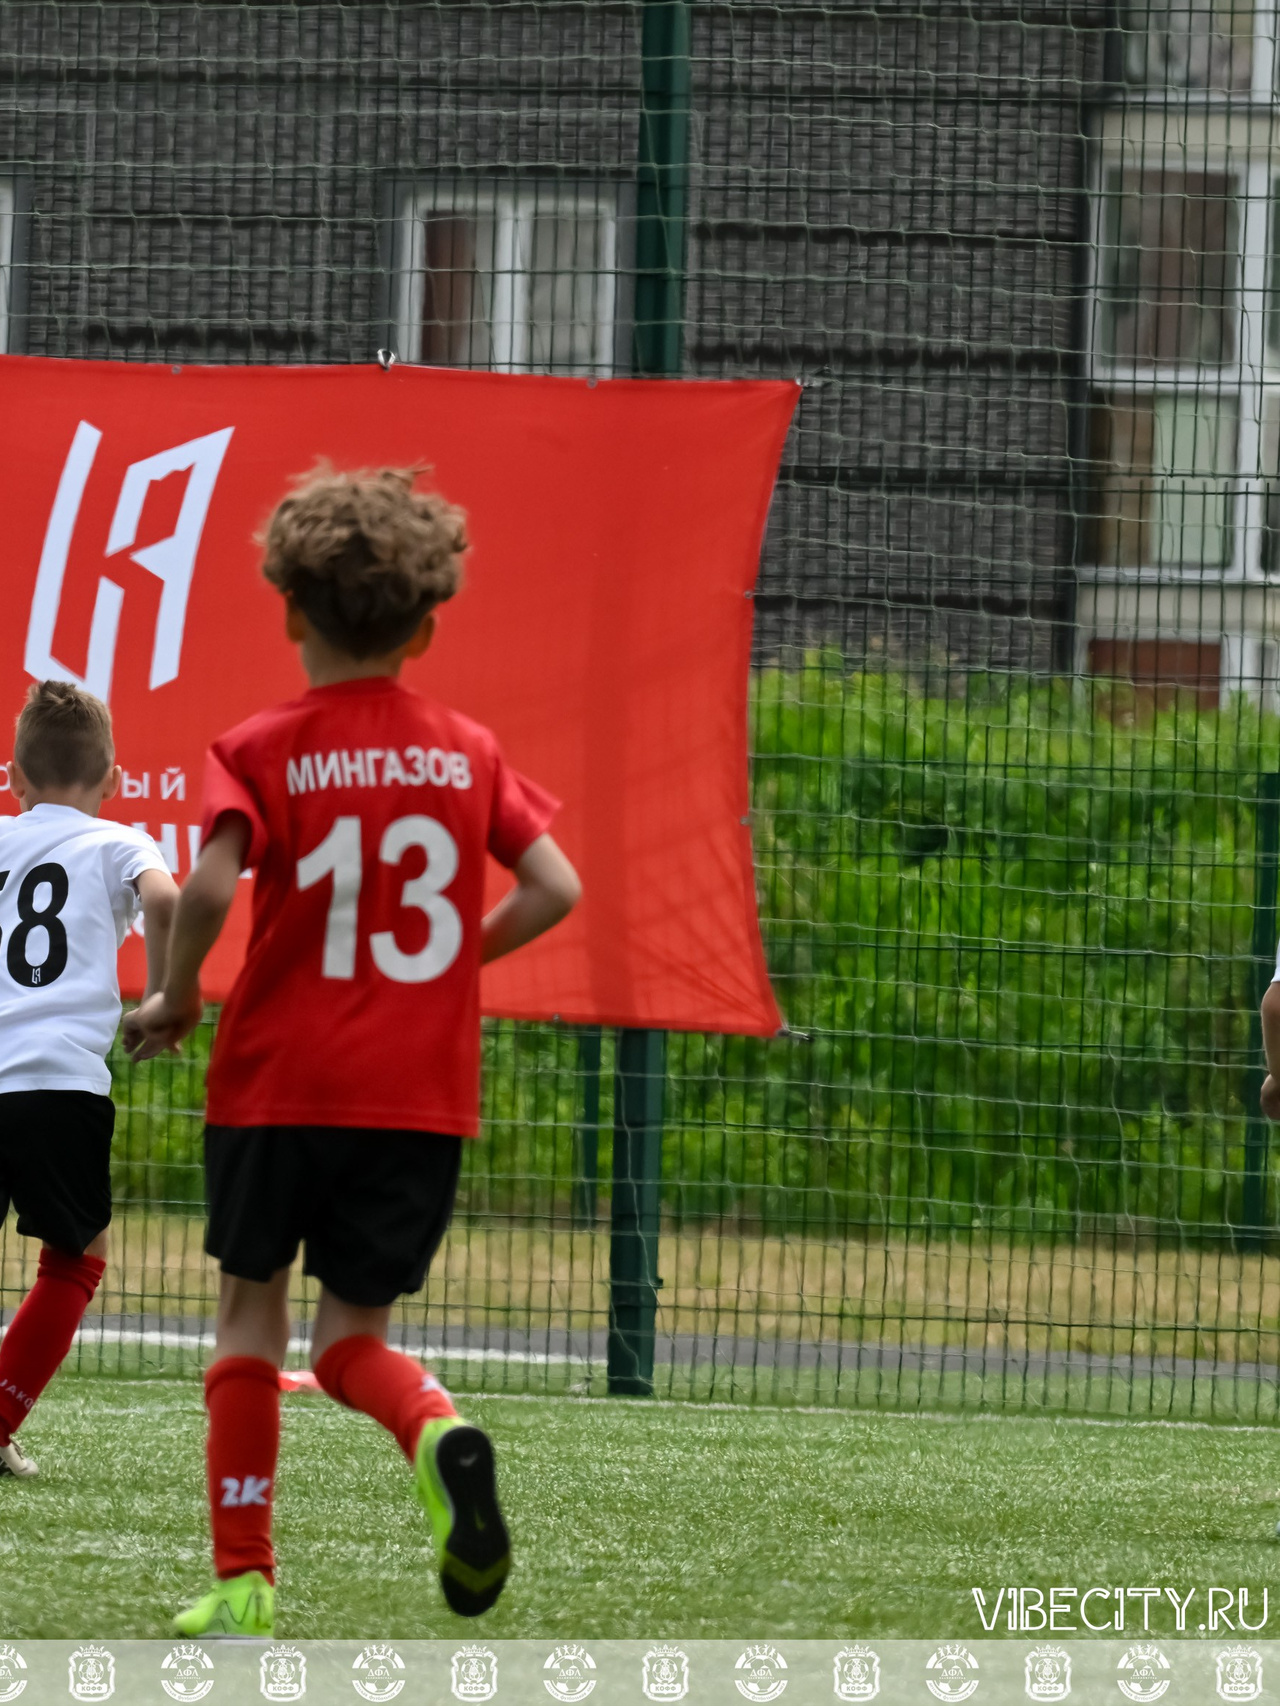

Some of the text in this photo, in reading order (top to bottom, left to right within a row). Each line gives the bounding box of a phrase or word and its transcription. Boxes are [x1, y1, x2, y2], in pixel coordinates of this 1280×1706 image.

[286, 745, 472, 796] МИНГАЗОВ
[296, 814, 463, 984] 13
[221, 1475, 270, 1507] 2K
